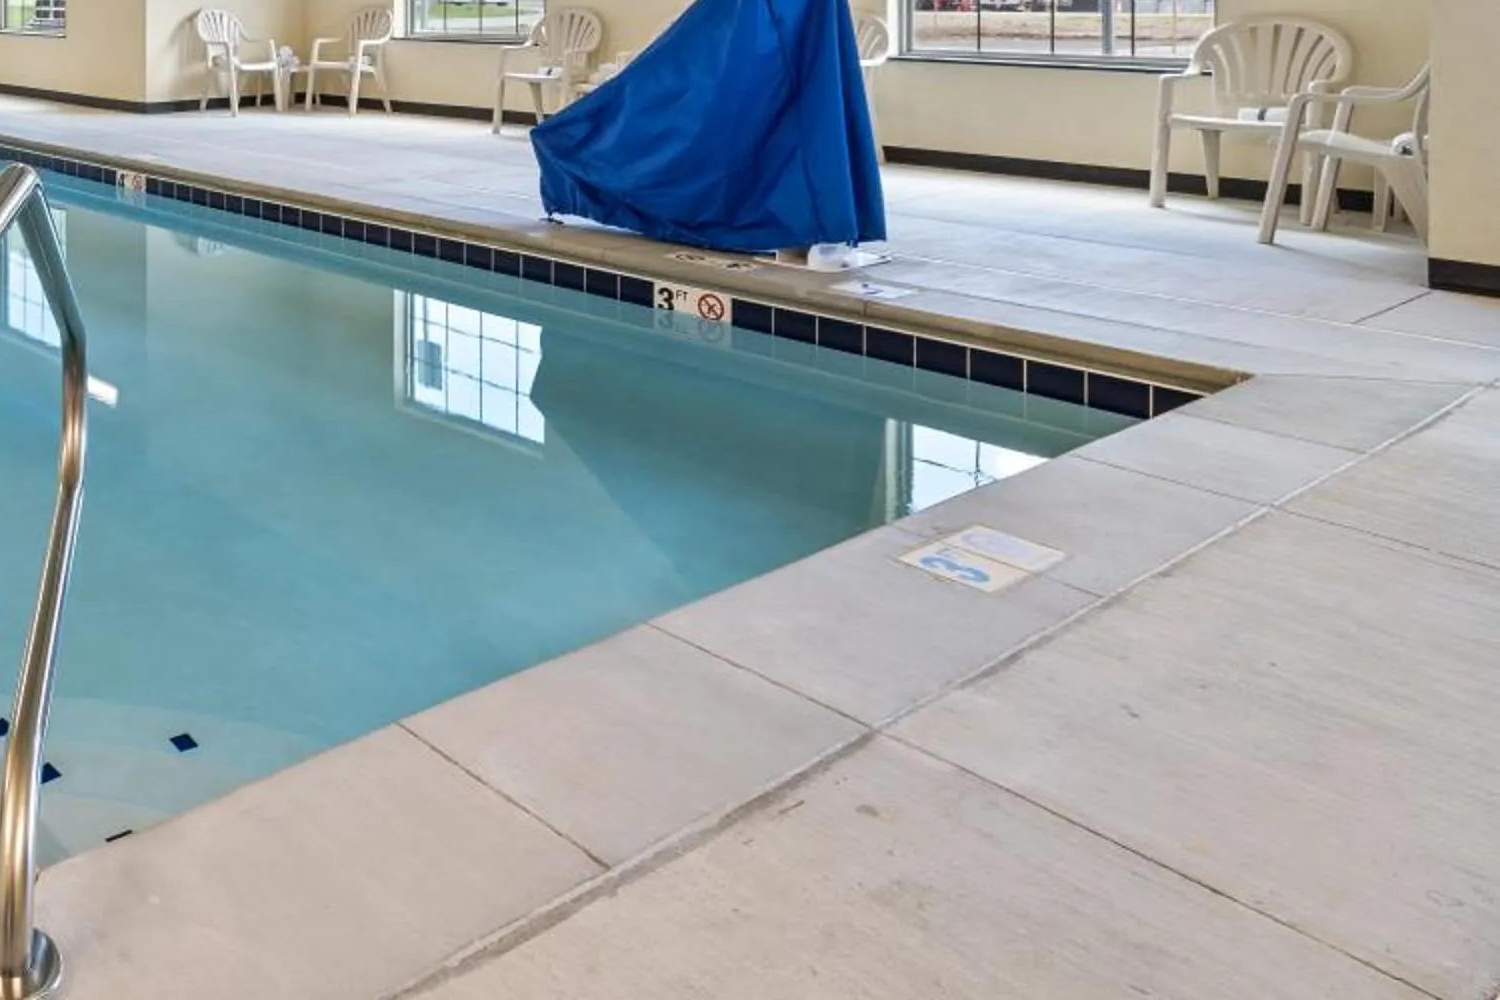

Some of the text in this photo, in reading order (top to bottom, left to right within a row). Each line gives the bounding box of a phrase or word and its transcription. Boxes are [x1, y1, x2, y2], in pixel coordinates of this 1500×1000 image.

[658, 287, 689, 310] 3 FT
[920, 555, 990, 582] 3
